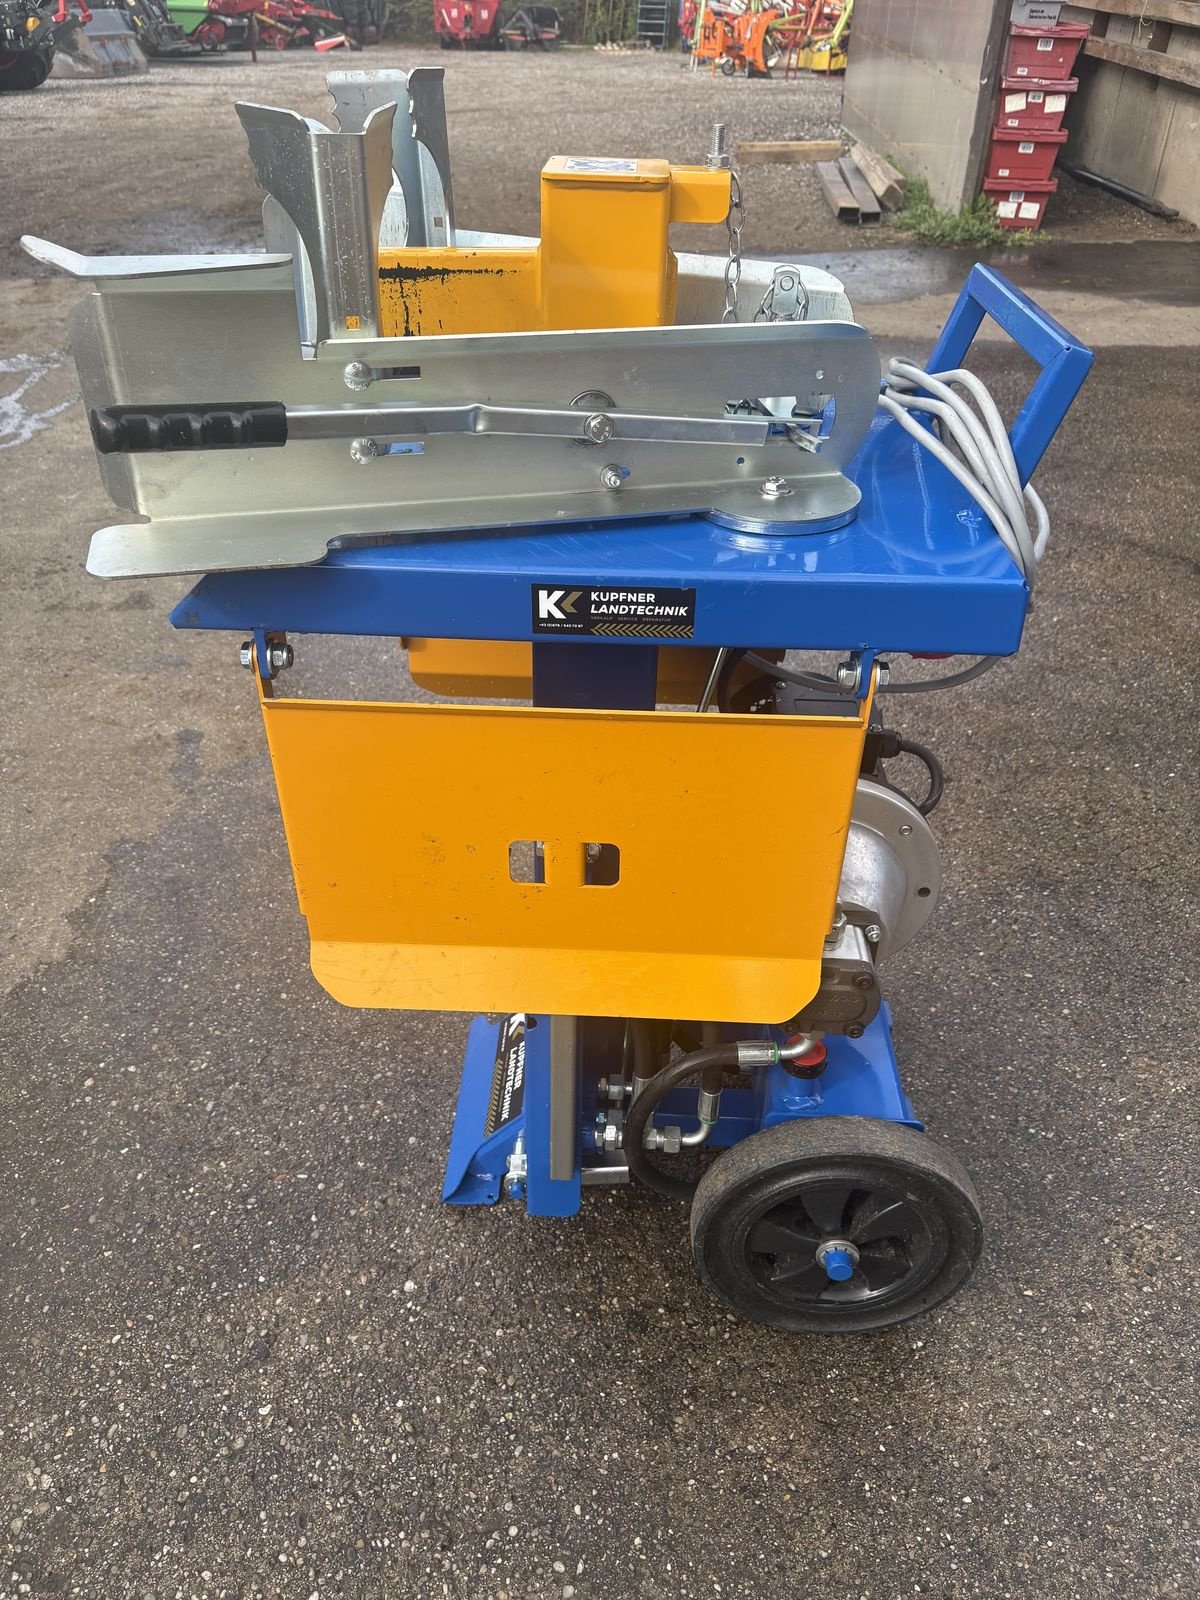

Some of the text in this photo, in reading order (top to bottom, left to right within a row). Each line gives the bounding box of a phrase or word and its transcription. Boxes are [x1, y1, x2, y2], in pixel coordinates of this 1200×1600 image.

[539, 590, 566, 619] K
[591, 591, 655, 603] KUPFNER
[591, 604, 688, 616] LANDTECHNIK
[514, 1041, 525, 1090] KUPFNER
[500, 1046, 517, 1122] LANDTECHNIK
